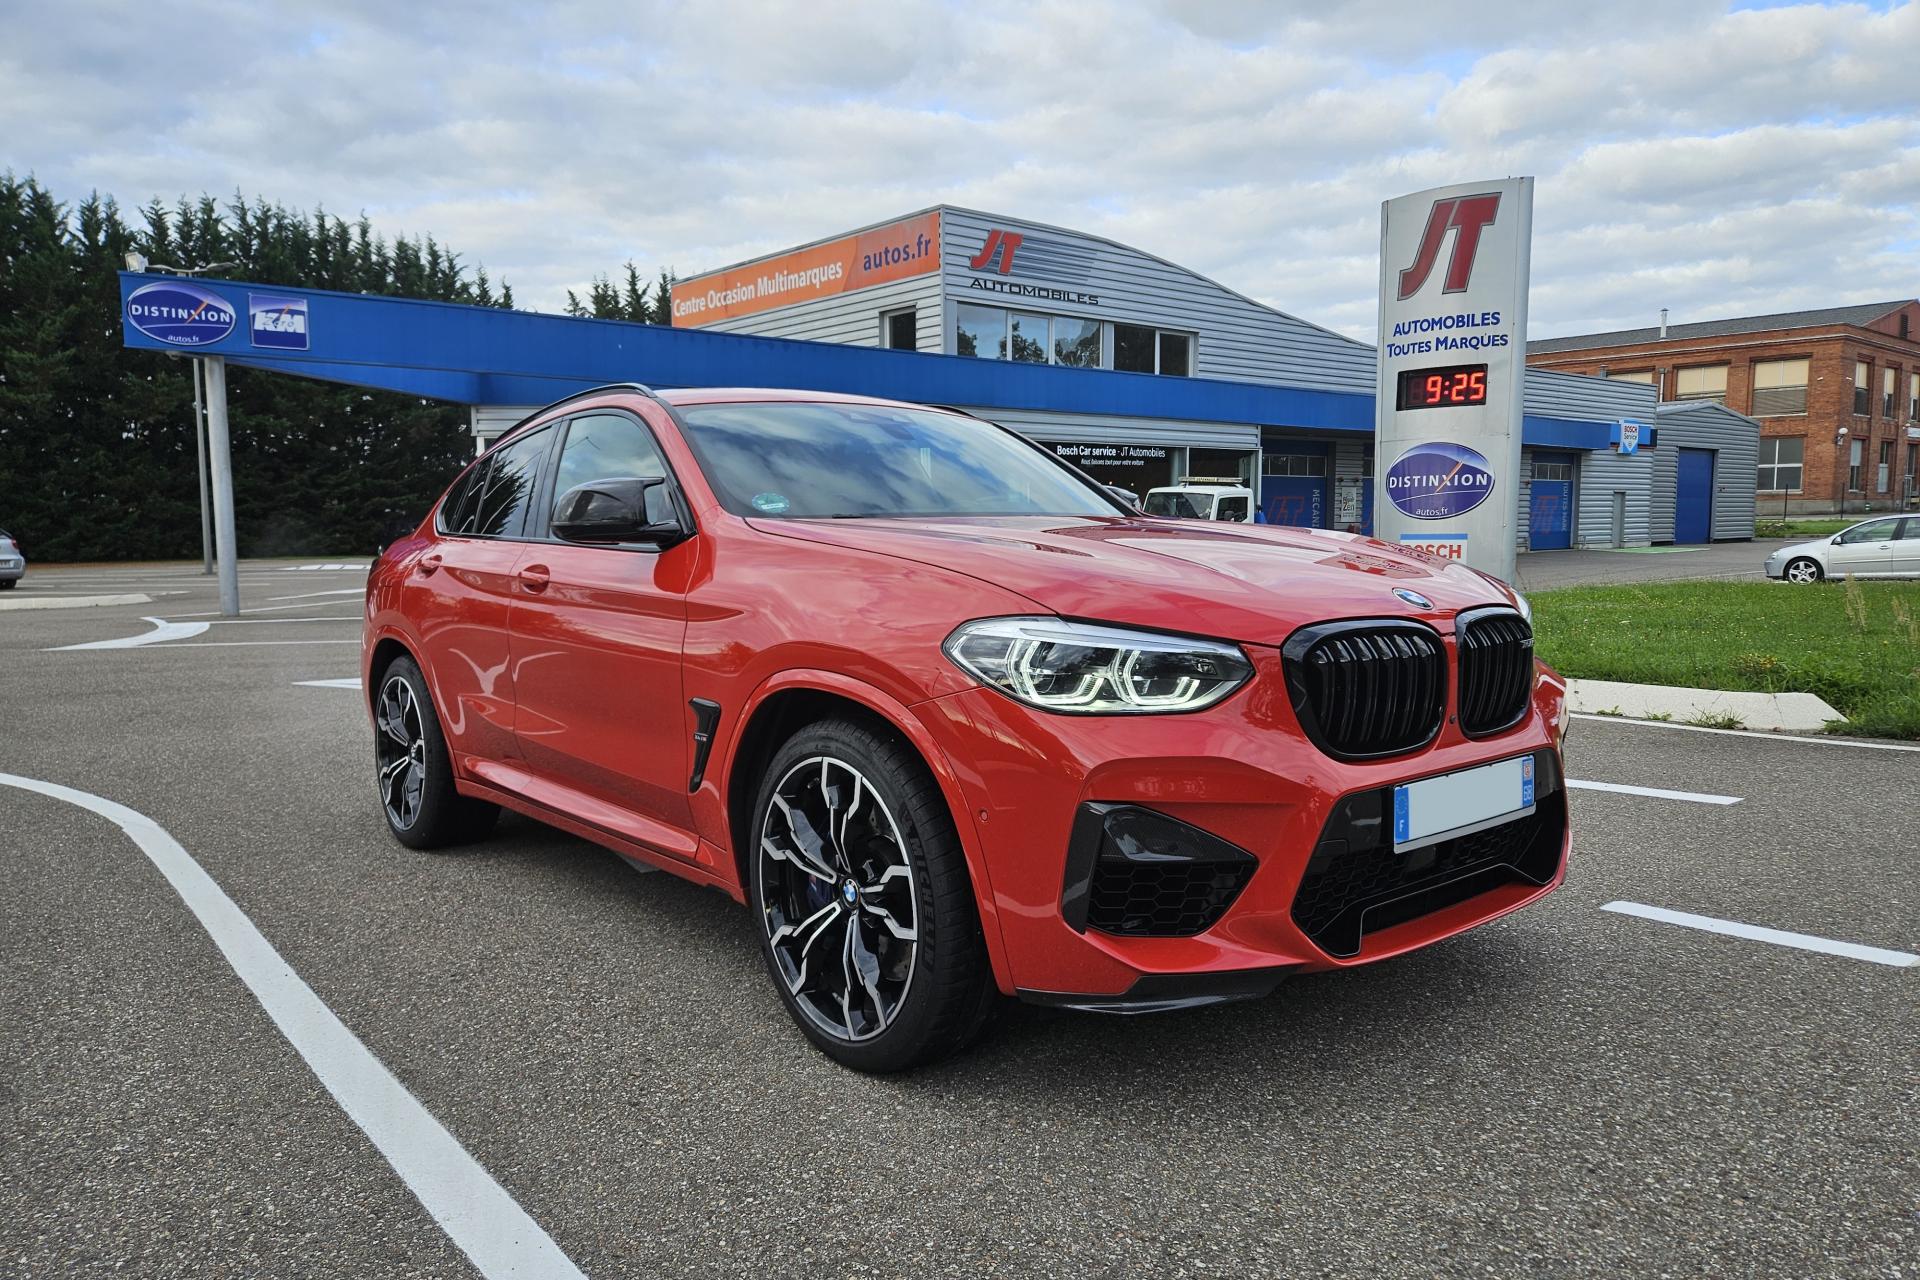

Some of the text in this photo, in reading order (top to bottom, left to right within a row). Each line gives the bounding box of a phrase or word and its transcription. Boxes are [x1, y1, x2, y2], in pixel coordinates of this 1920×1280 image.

[863, 234, 931, 271] autos.fr
[969, 228, 1025, 276] JT
[1397, 191, 1503, 302] JT
[673, 261, 843, 317] Centre Occasion Multimarques
[970, 278, 1100, 305] AUTOMOBILES
[131, 303, 231, 324] DISTINXION
[254, 311, 306, 334] KM
[1393, 311, 1501, 337] AUTOMOBILES
[167, 335, 200, 343] autos.fr
[1387, 334, 1509, 358] TOUTES MARQUES
[1426, 372, 1486, 404] 9:25
[1056, 445, 1166, 458] Bosch Car service JT Automobiles
[1389, 472, 1489, 490] DISTINXION
[1415, 506, 1449, 517] autos.fr
[1403, 544, 1462, 559] OSCH
